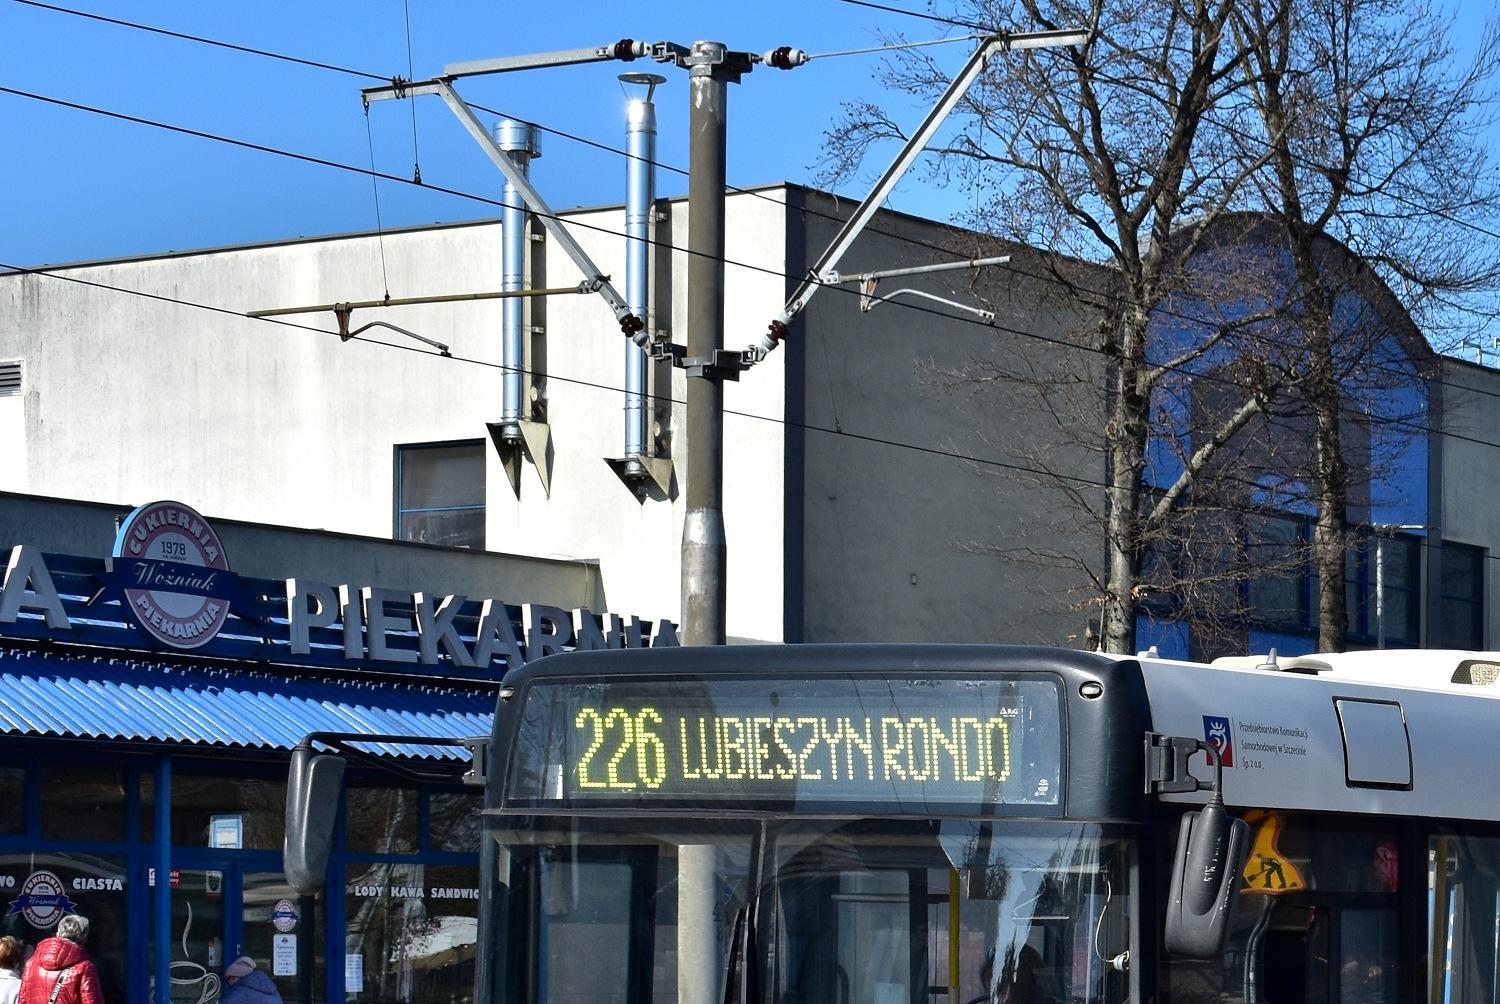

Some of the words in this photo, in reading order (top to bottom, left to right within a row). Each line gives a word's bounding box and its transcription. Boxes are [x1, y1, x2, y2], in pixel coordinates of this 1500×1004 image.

[130, 509, 219, 565] CUKIERNIA
[161, 541, 186, 556] 1978
[133, 562, 217, 591] Woźniak
[136, 595, 220, 639] PIEKARNIA
[575, 708, 667, 788] 226
[680, 717, 874, 781] LUBIESZYN
[884, 717, 1011, 782] RONDO
[72, 878, 123, 891] CIASTA
[355, 885, 383, 897] LODY
[391, 886, 425, 898] KAWA
